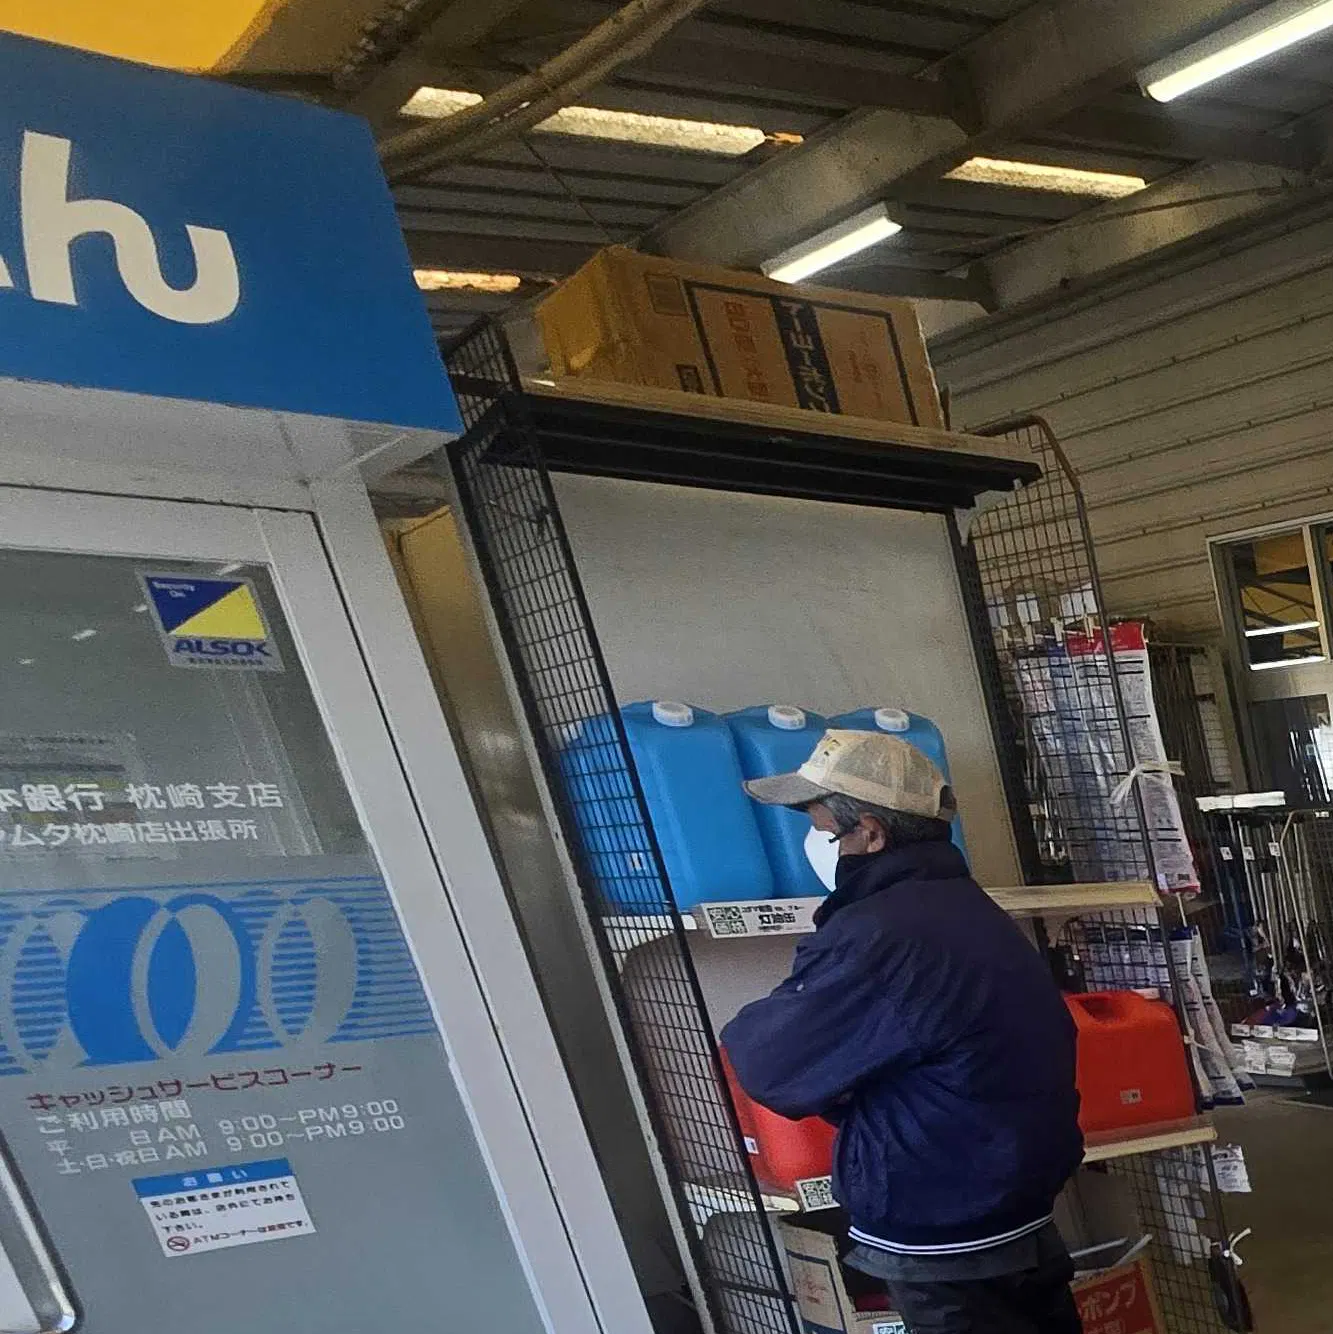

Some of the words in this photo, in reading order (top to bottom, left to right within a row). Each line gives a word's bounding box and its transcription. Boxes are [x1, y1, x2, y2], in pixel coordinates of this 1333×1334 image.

[173, 639, 272, 657] ALSOK
[125, 781, 284, 810] 枕崎支店
[0, 818, 259, 847] ムタ枕崎店出張所
[26, 1061, 363, 1111] キャッシュサービスコーナー
[36, 1099, 193, 1135] ご利用時間
